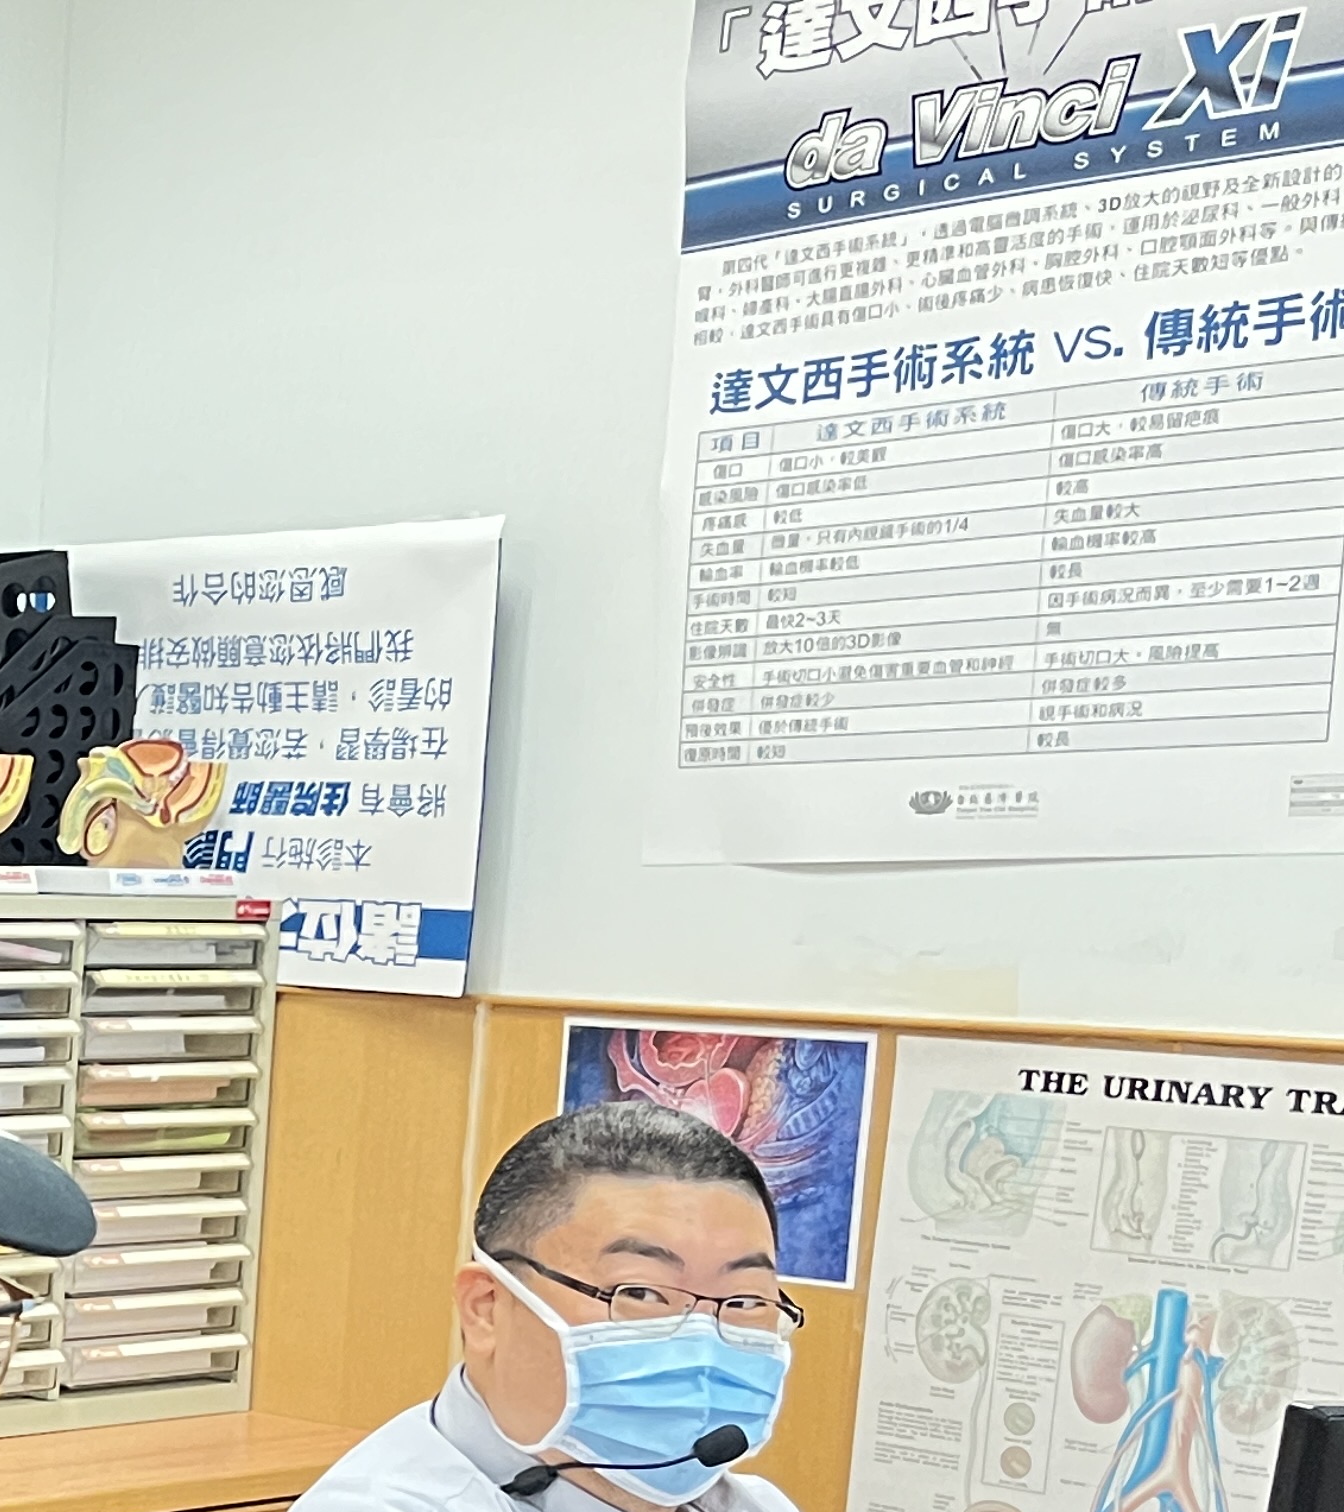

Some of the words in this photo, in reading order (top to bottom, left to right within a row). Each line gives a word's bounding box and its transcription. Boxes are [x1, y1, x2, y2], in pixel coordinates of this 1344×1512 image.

[784, 107, 888, 190] da
[912, 54, 1141, 167] Vinci
[1144, 7, 1309, 131] Xi
[787, 166, 1026, 219] SURGICAL
[1074, 122, 1281, 168] SYSTEM
[709, 328, 1035, 416] 達文西手術系統
[1054, 325, 1124, 363] VS.
[1144, 288, 1344, 360] 傳統手術
[1141, 371, 1263, 403] 傳統手術
[816, 401, 1007, 443] 達文西手術系統
[711, 428, 762, 454] 項目
[1056, 477, 1089, 497] 較高
[1053, 502, 1140, 527] 失血量較大
[173, 566, 347, 607] 感恩您的合作
[1049, 561, 1083, 580] 較長
[692, 671, 737, 691] 安全性
[1037, 731, 1070, 749] 較長
[228, 780, 352, 816] 住院醫師
[361, 782, 447, 817] 將會有
[262, 836, 372, 872] 本診施行
[1018, 1068, 1089, 1097] THE
[1103, 1074, 1274, 1110] URINARY
[1286, 1088, 1344, 1115] TR
